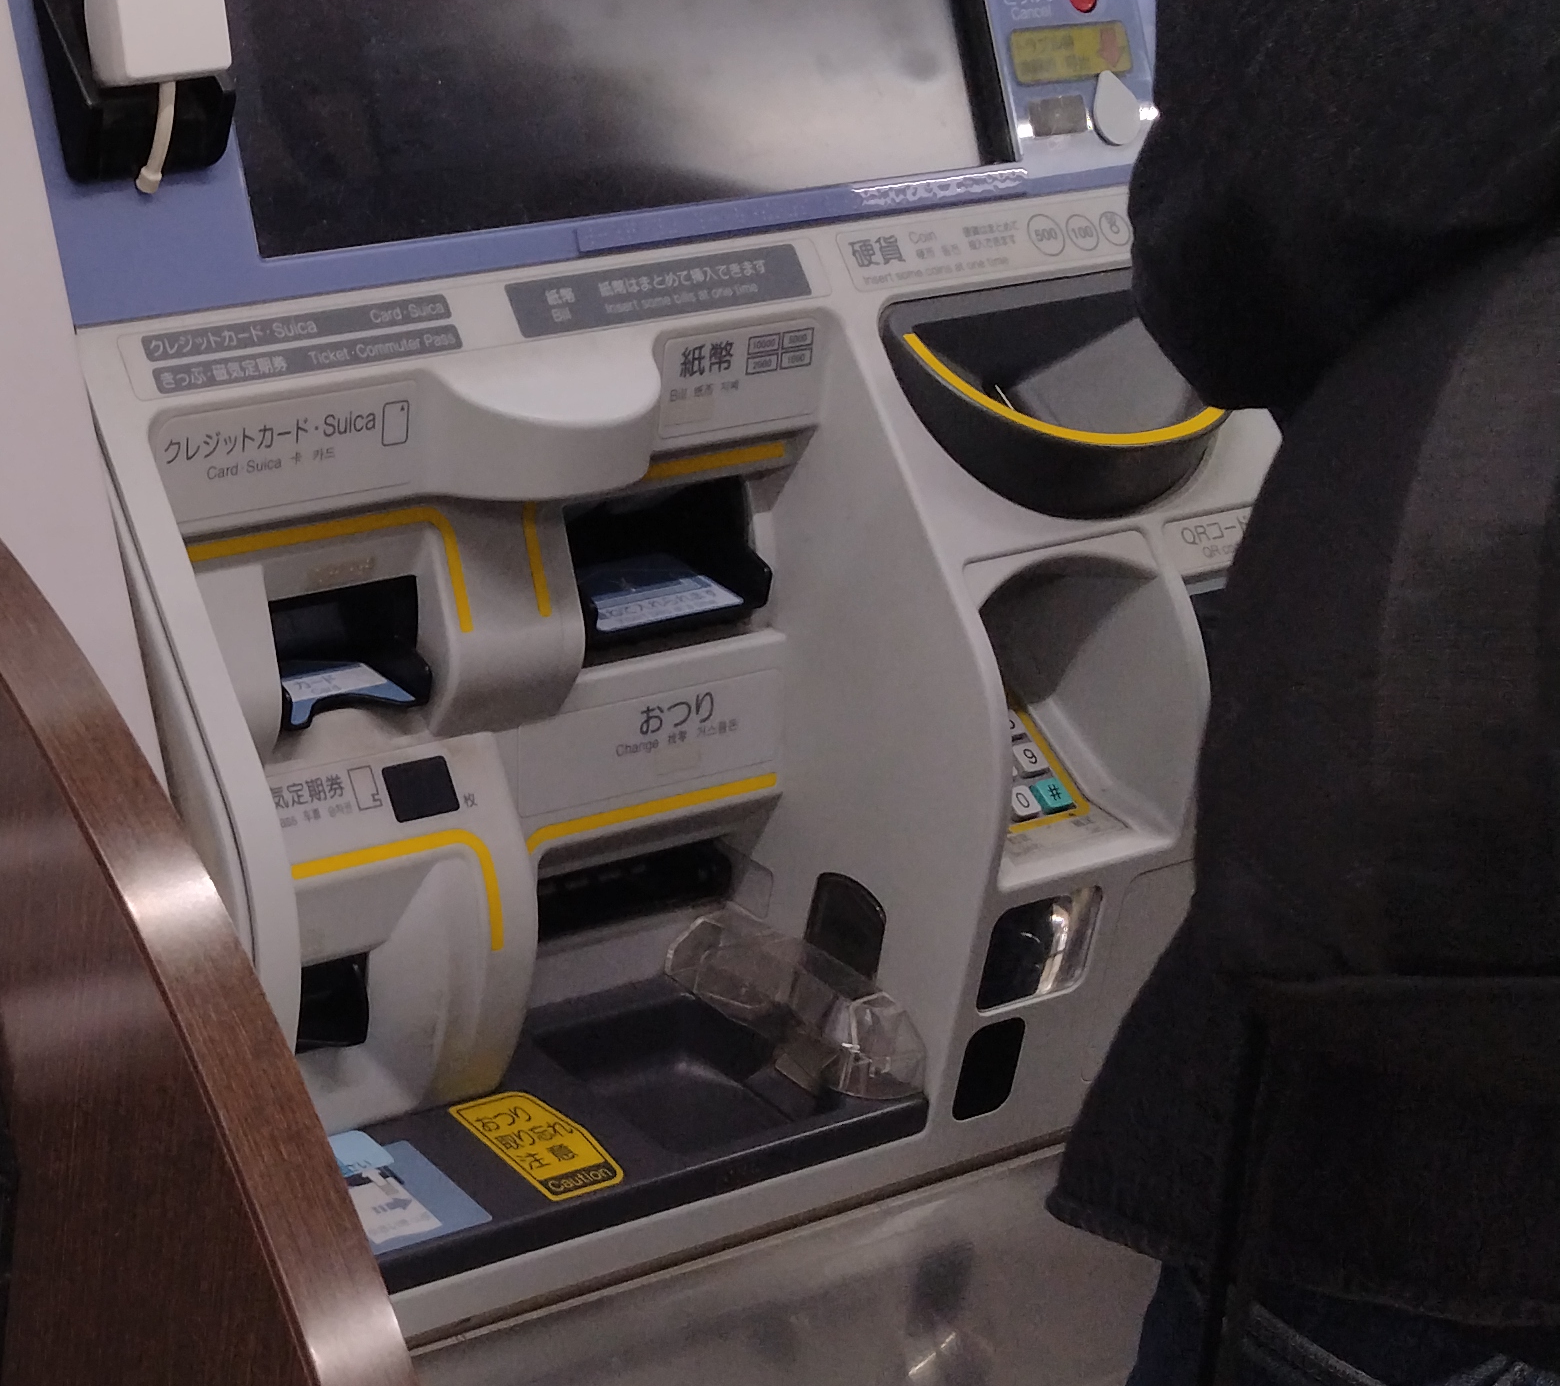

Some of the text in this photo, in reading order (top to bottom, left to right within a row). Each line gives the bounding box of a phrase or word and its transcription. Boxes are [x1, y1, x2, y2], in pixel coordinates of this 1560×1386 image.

[847, 234, 907, 269] 硬貨
[679, 340, 735, 379] 紙幣
[639, 691, 716, 736] おつり
[615, 729, 660, 758] Change
[1022, 746, 1039, 767] 9
[462, 792, 479, 809] 枚
[1015, 782, 1062, 810] 0 #
[474, 1104, 533, 1132] おつり
[494, 1119, 575, 1152] 取り忘れ
[547, 1164, 613, 1194] Caution
